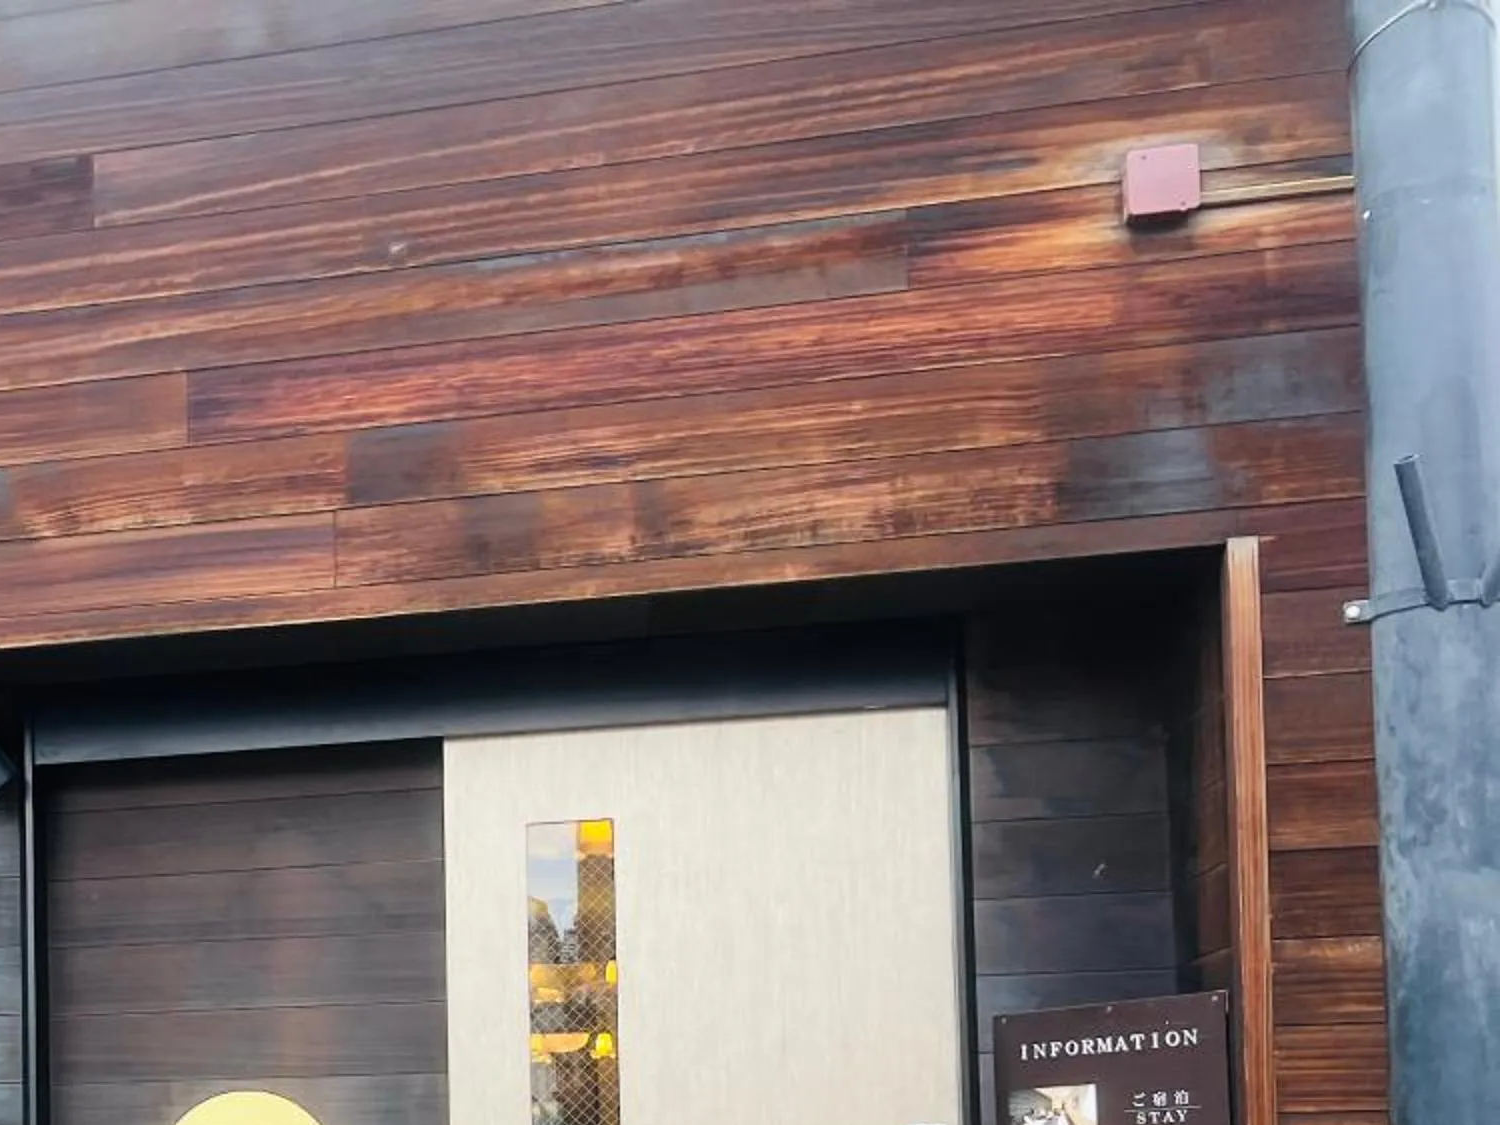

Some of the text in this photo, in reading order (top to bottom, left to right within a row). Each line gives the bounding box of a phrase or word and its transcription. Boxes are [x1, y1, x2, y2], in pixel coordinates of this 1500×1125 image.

[1020, 1028, 1199, 1060] INFORMATION
[1132, 1089, 1190, 1108] ご宿泊
[1136, 1109, 1189, 1125] STAY
